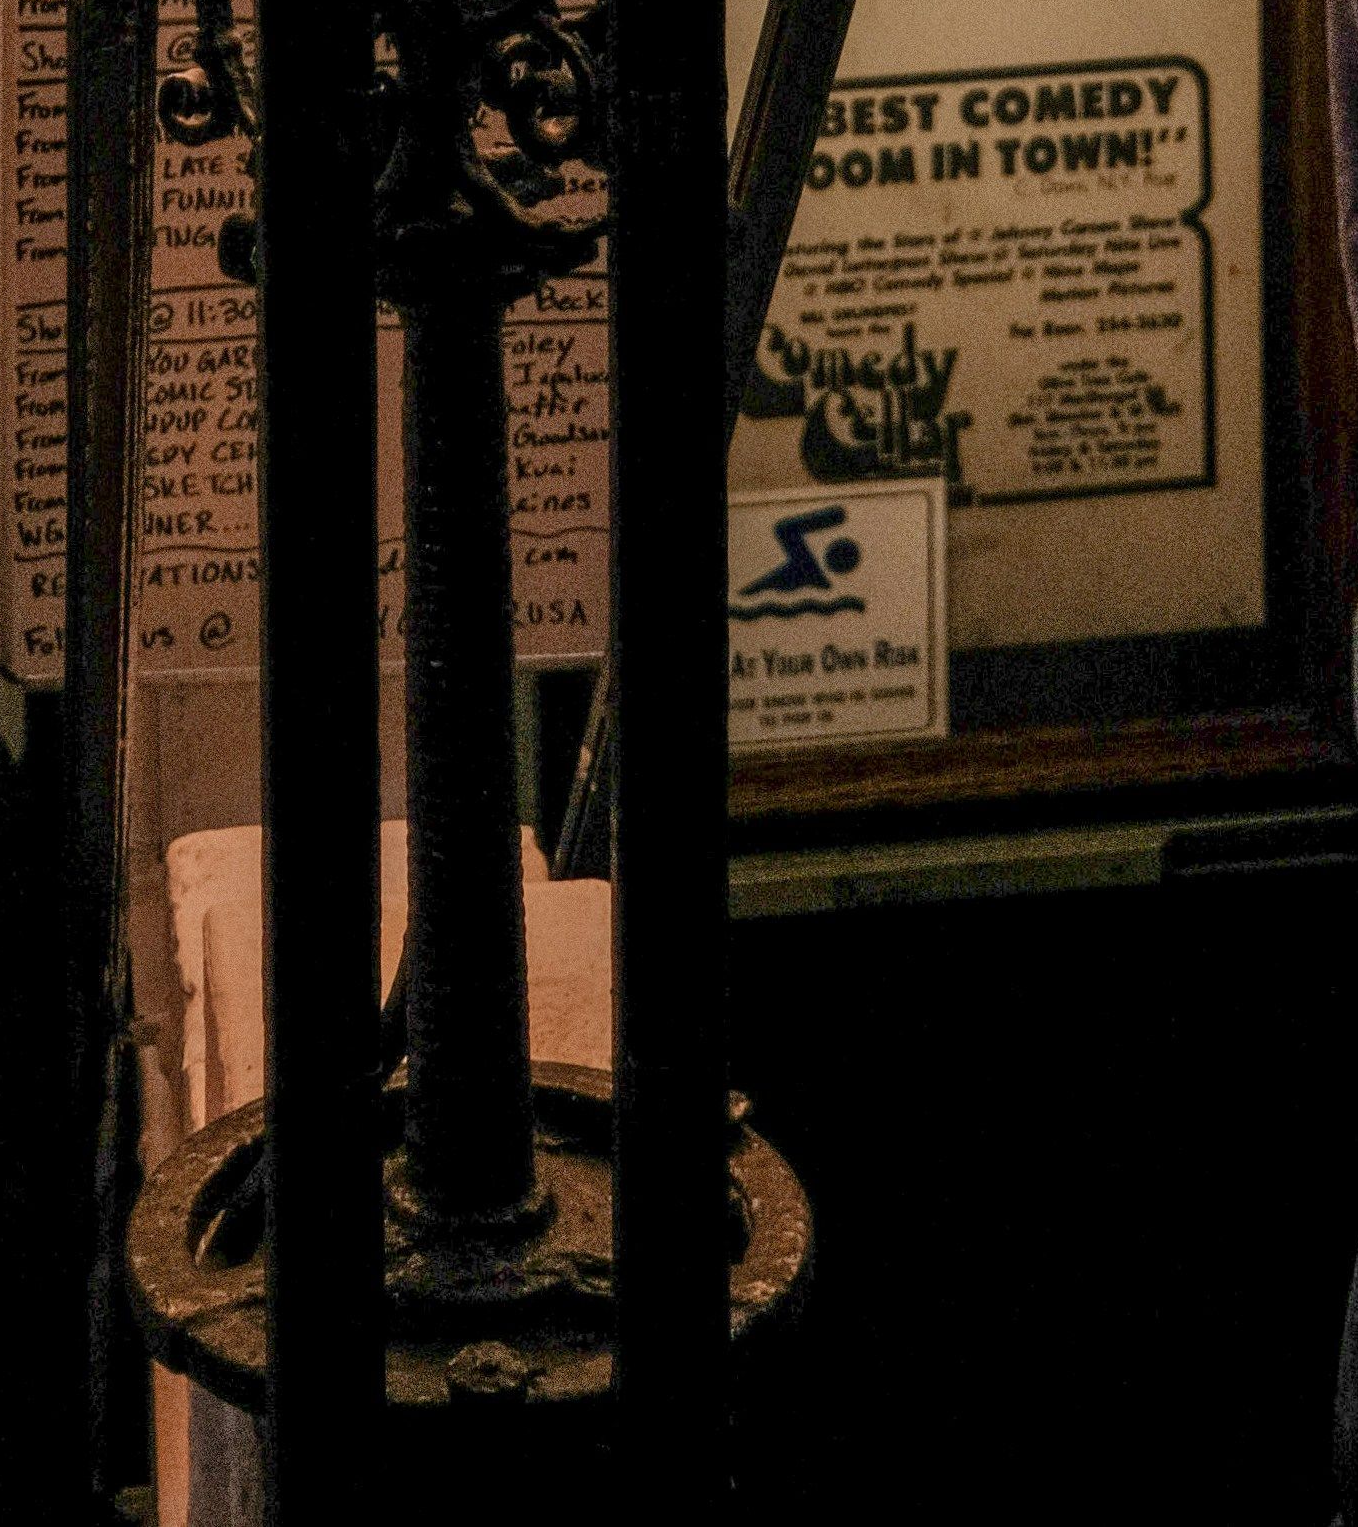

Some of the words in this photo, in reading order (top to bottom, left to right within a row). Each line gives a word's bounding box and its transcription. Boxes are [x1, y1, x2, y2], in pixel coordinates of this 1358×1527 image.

[959, 75, 1181, 129] COMEDY
[806, 146, 918, 190] OOM
[931, 140, 981, 182] IN
